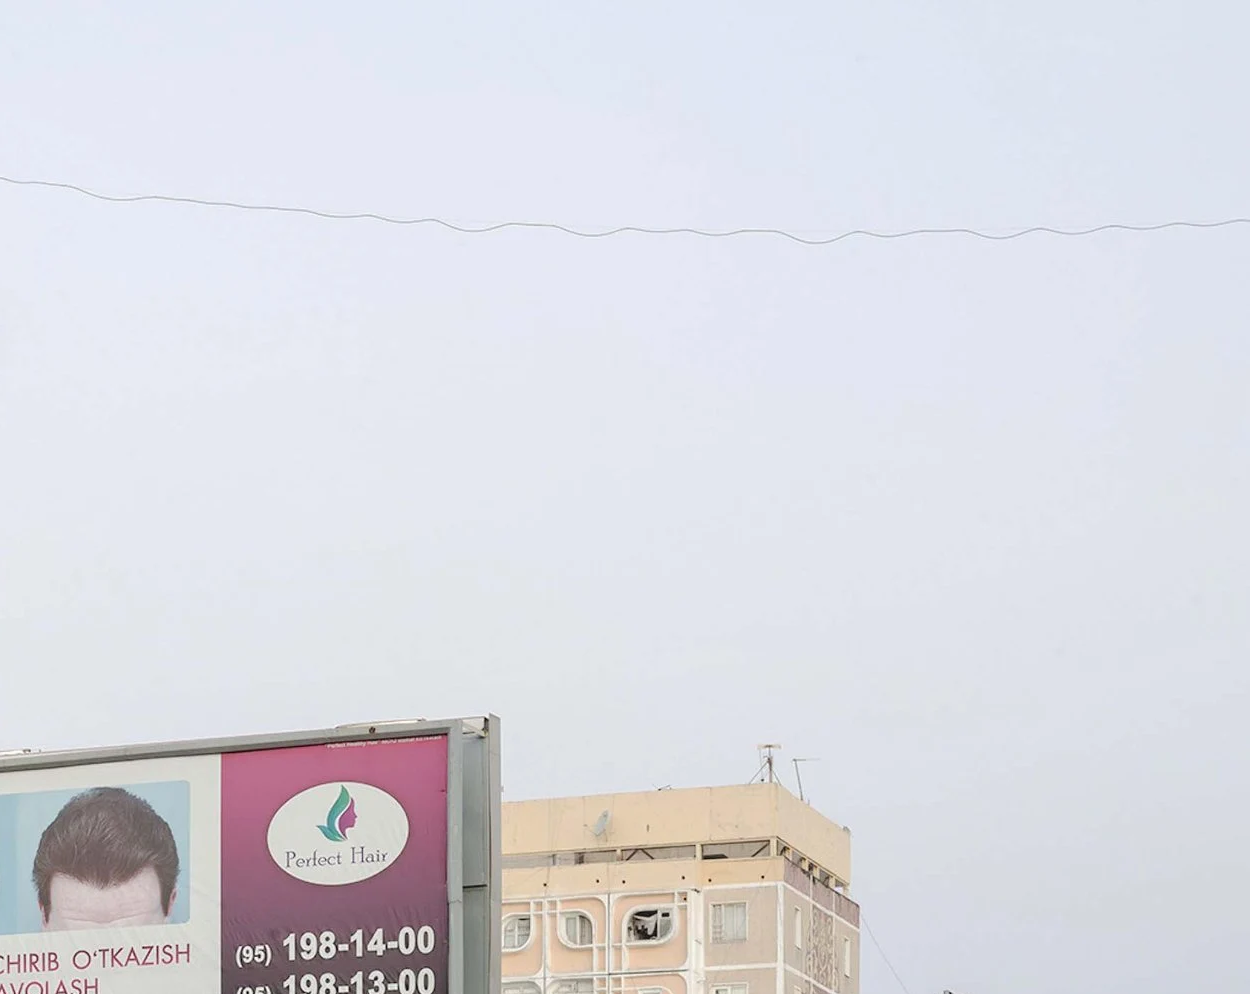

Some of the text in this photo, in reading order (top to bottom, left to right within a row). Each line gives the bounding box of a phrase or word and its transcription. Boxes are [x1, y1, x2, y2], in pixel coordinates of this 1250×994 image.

[285, 845, 389, 868] Perfect Hair
[236, 925, 435, 968] (95) 198-14-00
